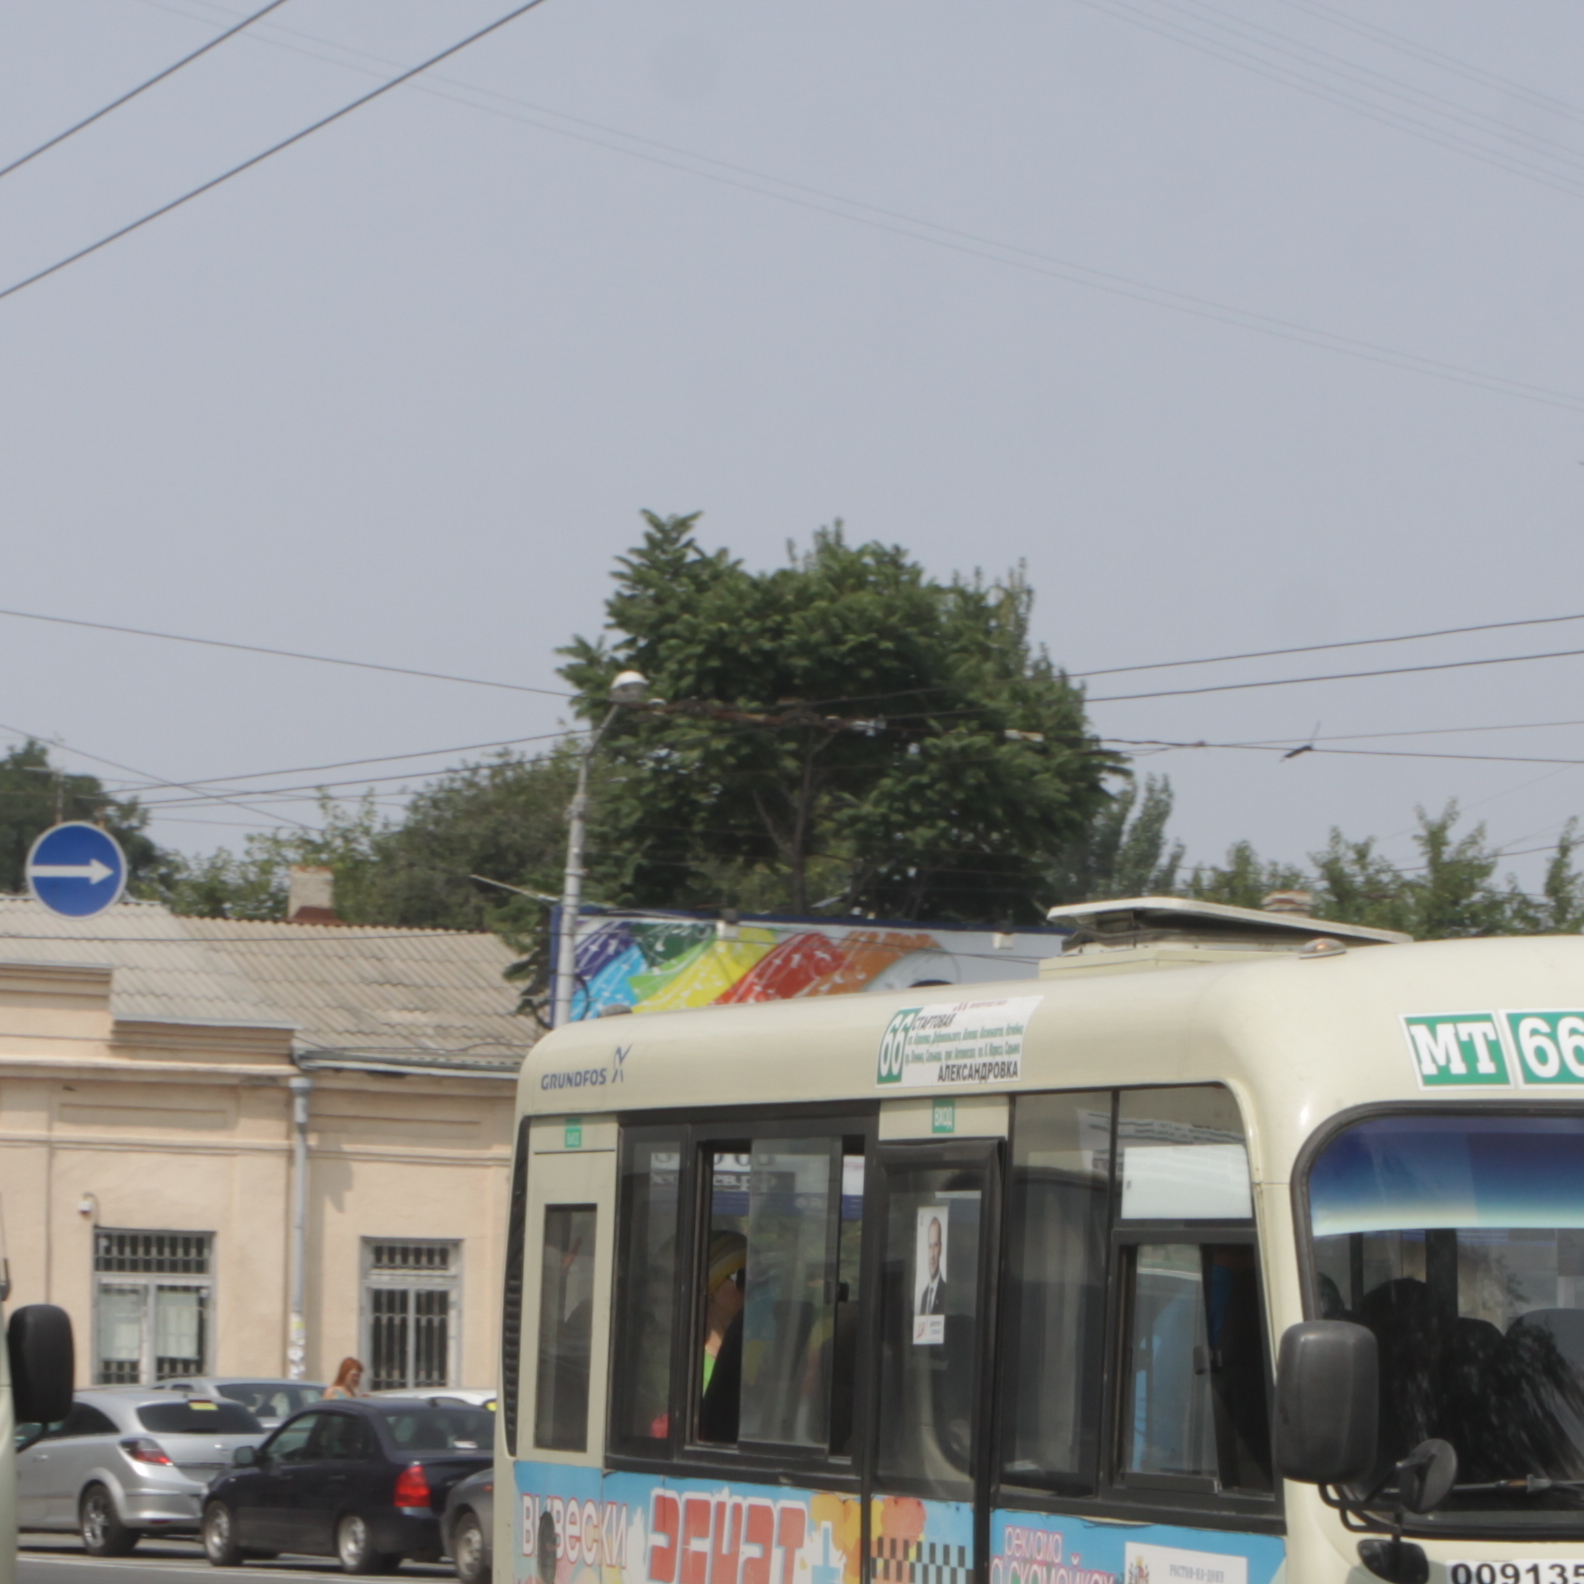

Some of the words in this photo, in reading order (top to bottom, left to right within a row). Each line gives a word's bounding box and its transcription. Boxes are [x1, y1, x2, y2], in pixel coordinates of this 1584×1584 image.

[880, 1012, 916, 1078] 66
[1409, 1021, 1498, 1076] МТ
[540, 1067, 608, 1091] GRUNDFOS
[937, 1060, 1018, 1083] АЛЕКСАНДРОВКА
[1004, 1524, 1064, 1566] реклама
